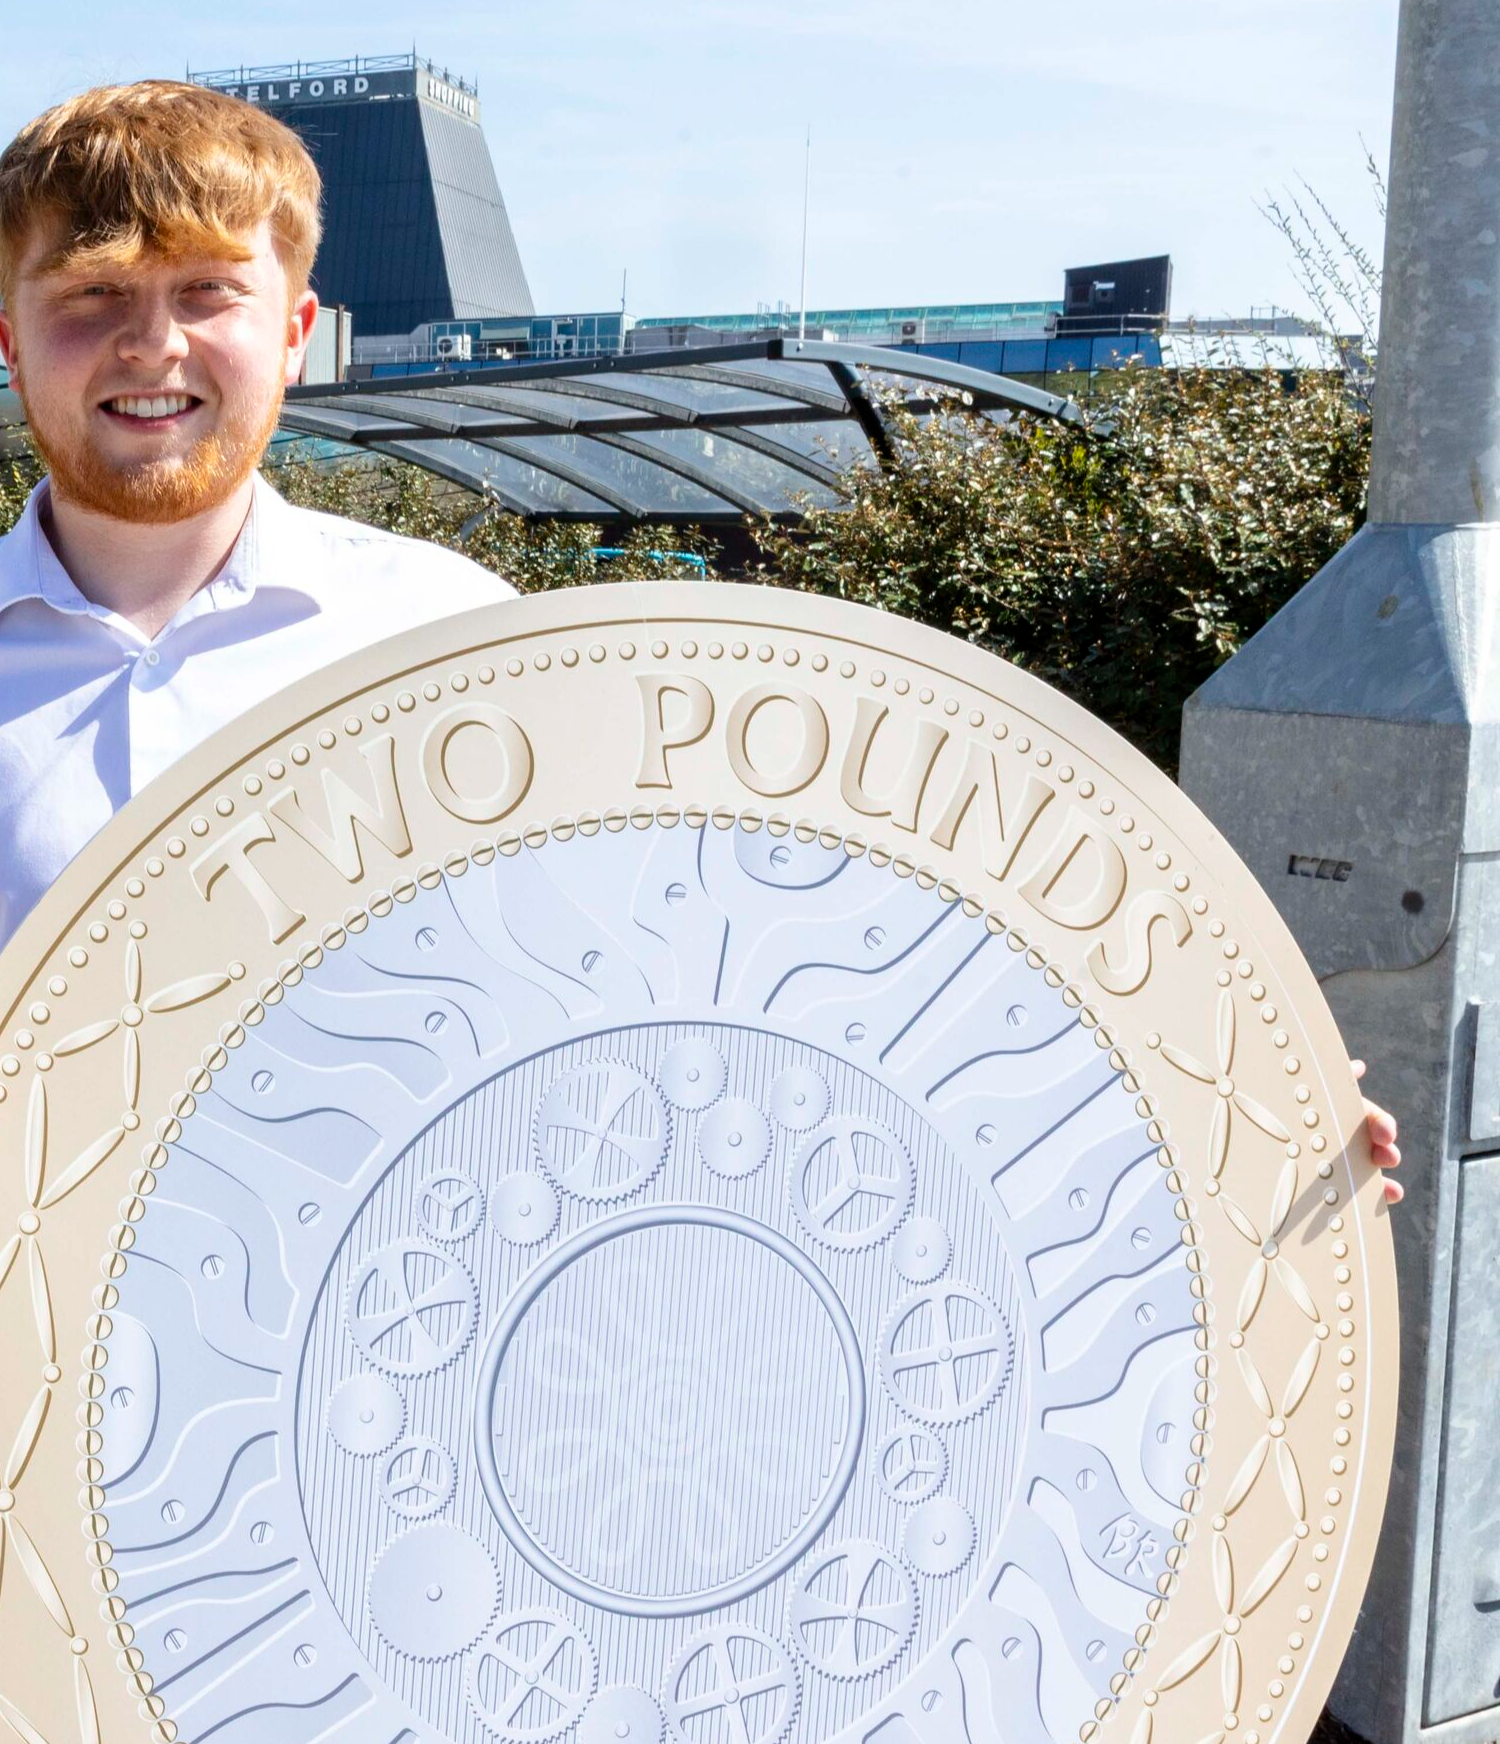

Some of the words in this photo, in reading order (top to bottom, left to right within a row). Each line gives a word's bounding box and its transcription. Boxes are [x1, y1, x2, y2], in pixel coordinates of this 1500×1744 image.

[226, 77, 369, 102] TELFORD
[428, 78, 475, 117] SHOPPING
[188, 701, 534, 945] TWO
[634, 673, 1193, 996] POUNDS
